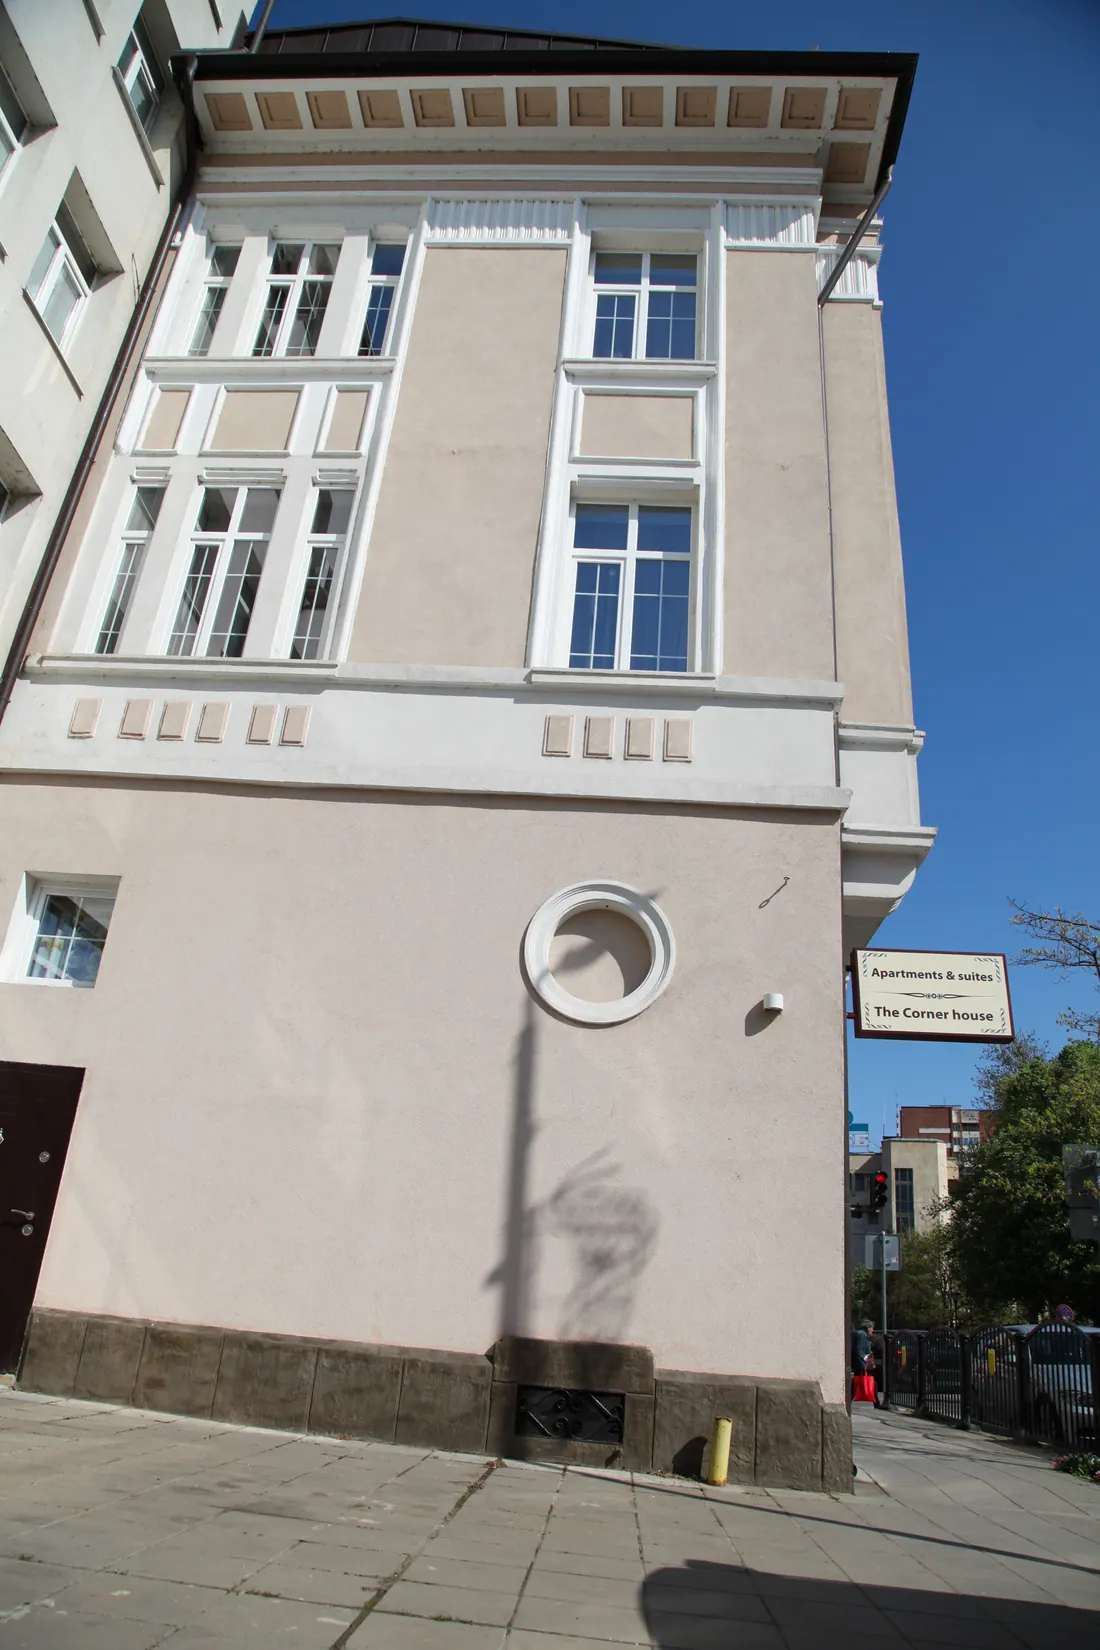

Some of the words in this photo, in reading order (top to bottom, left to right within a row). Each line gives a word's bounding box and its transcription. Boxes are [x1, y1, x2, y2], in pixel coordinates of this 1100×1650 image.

[871, 967, 943, 980] Apartments
[946, 971, 955, 980] &
[958, 972, 993, 982] suites
[874, 1006, 899, 1018] The
[903, 1007, 949, 1020] Corner
[952, 1009, 994, 1021] house
